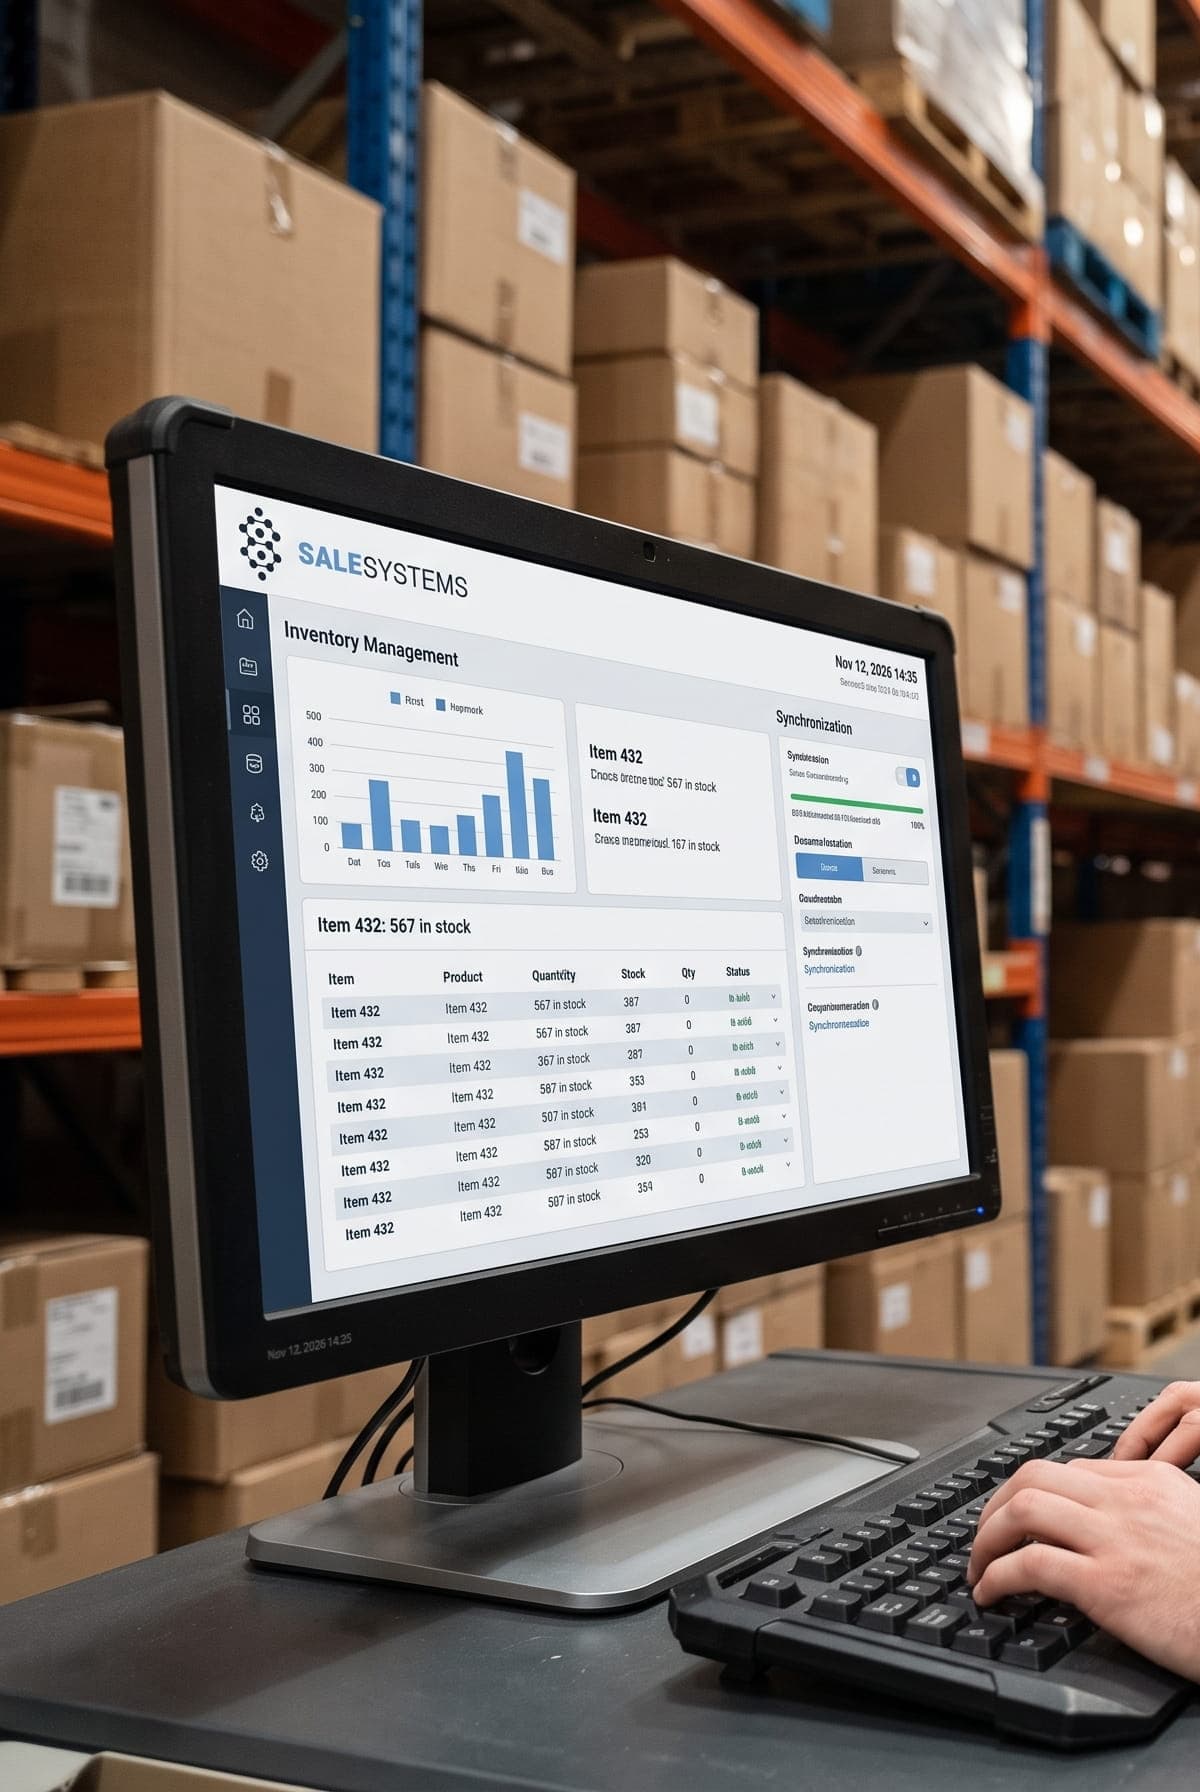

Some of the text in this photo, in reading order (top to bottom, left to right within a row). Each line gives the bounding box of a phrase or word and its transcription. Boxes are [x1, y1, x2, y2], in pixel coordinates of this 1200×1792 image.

[299, 541, 470, 597] SALESYSTEMS
[285, 620, 459, 667] Inventory Management
[836, 655, 917, 683] Nov 12, 2026 14:35
[306, 711, 321, 721] 500
[777, 710, 852, 735] Synchronization
[308, 737, 323, 747] 400
[590, 744, 643, 764] Item 432
[309, 763, 324, 773] 300
[685, 779, 692, 790] in
[695, 782, 717, 792] stock
[311, 790, 326, 799] 200
[313, 816, 328, 825] 100
[593, 808, 647, 826] Item 432
[324, 843, 329, 852] 0
[672, 839, 686, 849] 167
[688, 840, 696, 850] in
[698, 841, 720, 852] stock
[318, 917, 471, 933] Item 432: 567 in stock
[444, 971, 483, 982] Product
[622, 968, 645, 979] Stock
[682, 968, 695, 980] Qty
[726, 967, 750, 976] Status
[329, 973, 354, 985] Item
[535, 998, 586, 1010] 567 in stock
[685, 995, 689, 1004] 0
[332, 1005, 380, 1018] Item 432
[446, 1002, 487, 1014] Item 432
[626, 1023, 640, 1033] 387
[687, 1020, 691, 1029] 0
[448, 1031, 489, 1043] Item 432
[537, 1026, 588, 1039] 567 in stock
[334, 1036, 382, 1050] Item 432
[688, 1045, 693, 1055] 0
[538, 1053, 590, 1066] 367 in stock
[450, 1060, 491, 1073] Item 432
[336, 1067, 384, 1081] Item 432
[630, 1075, 644, 1086] 353
[691, 1071, 695, 1080] 0
[559, 1083, 567, 1092] in
[569, 1080, 592, 1092] stock
[452, 1089, 493, 1103] Item 432
[693, 1096, 697, 1106] 0
[338, 1098, 386, 1113] Item 432
[561, 1110, 569, 1120] in
[571, 1107, 594, 1119] stock
[454, 1118, 495, 1132] Item 432
[695, 1122, 700, 1131] 0
[340, 1129, 388, 1145] Item 432
[634, 1128, 649, 1139] 253
[563, 1138, 571, 1148] in
[573, 1134, 596, 1147] stock
[456, 1147, 497, 1162] Item 432
[697, 1147, 702, 1157] 0
[636, 1155, 651, 1166] 320
[342, 1160, 390, 1176] Item 432
[565, 1166, 573, 1176] in
[576, 1162, 598, 1175] stock
[458, 1176, 500, 1192] Item 432
[699, 1173, 704, 1183] 0
[344, 1191, 392, 1208] Item 432
[567, 1194, 575, 1205] in
[578, 1189, 600, 1203] stock
[460, 1205, 502, 1222] Item 432
[346, 1222, 394, 1240] Item 432
